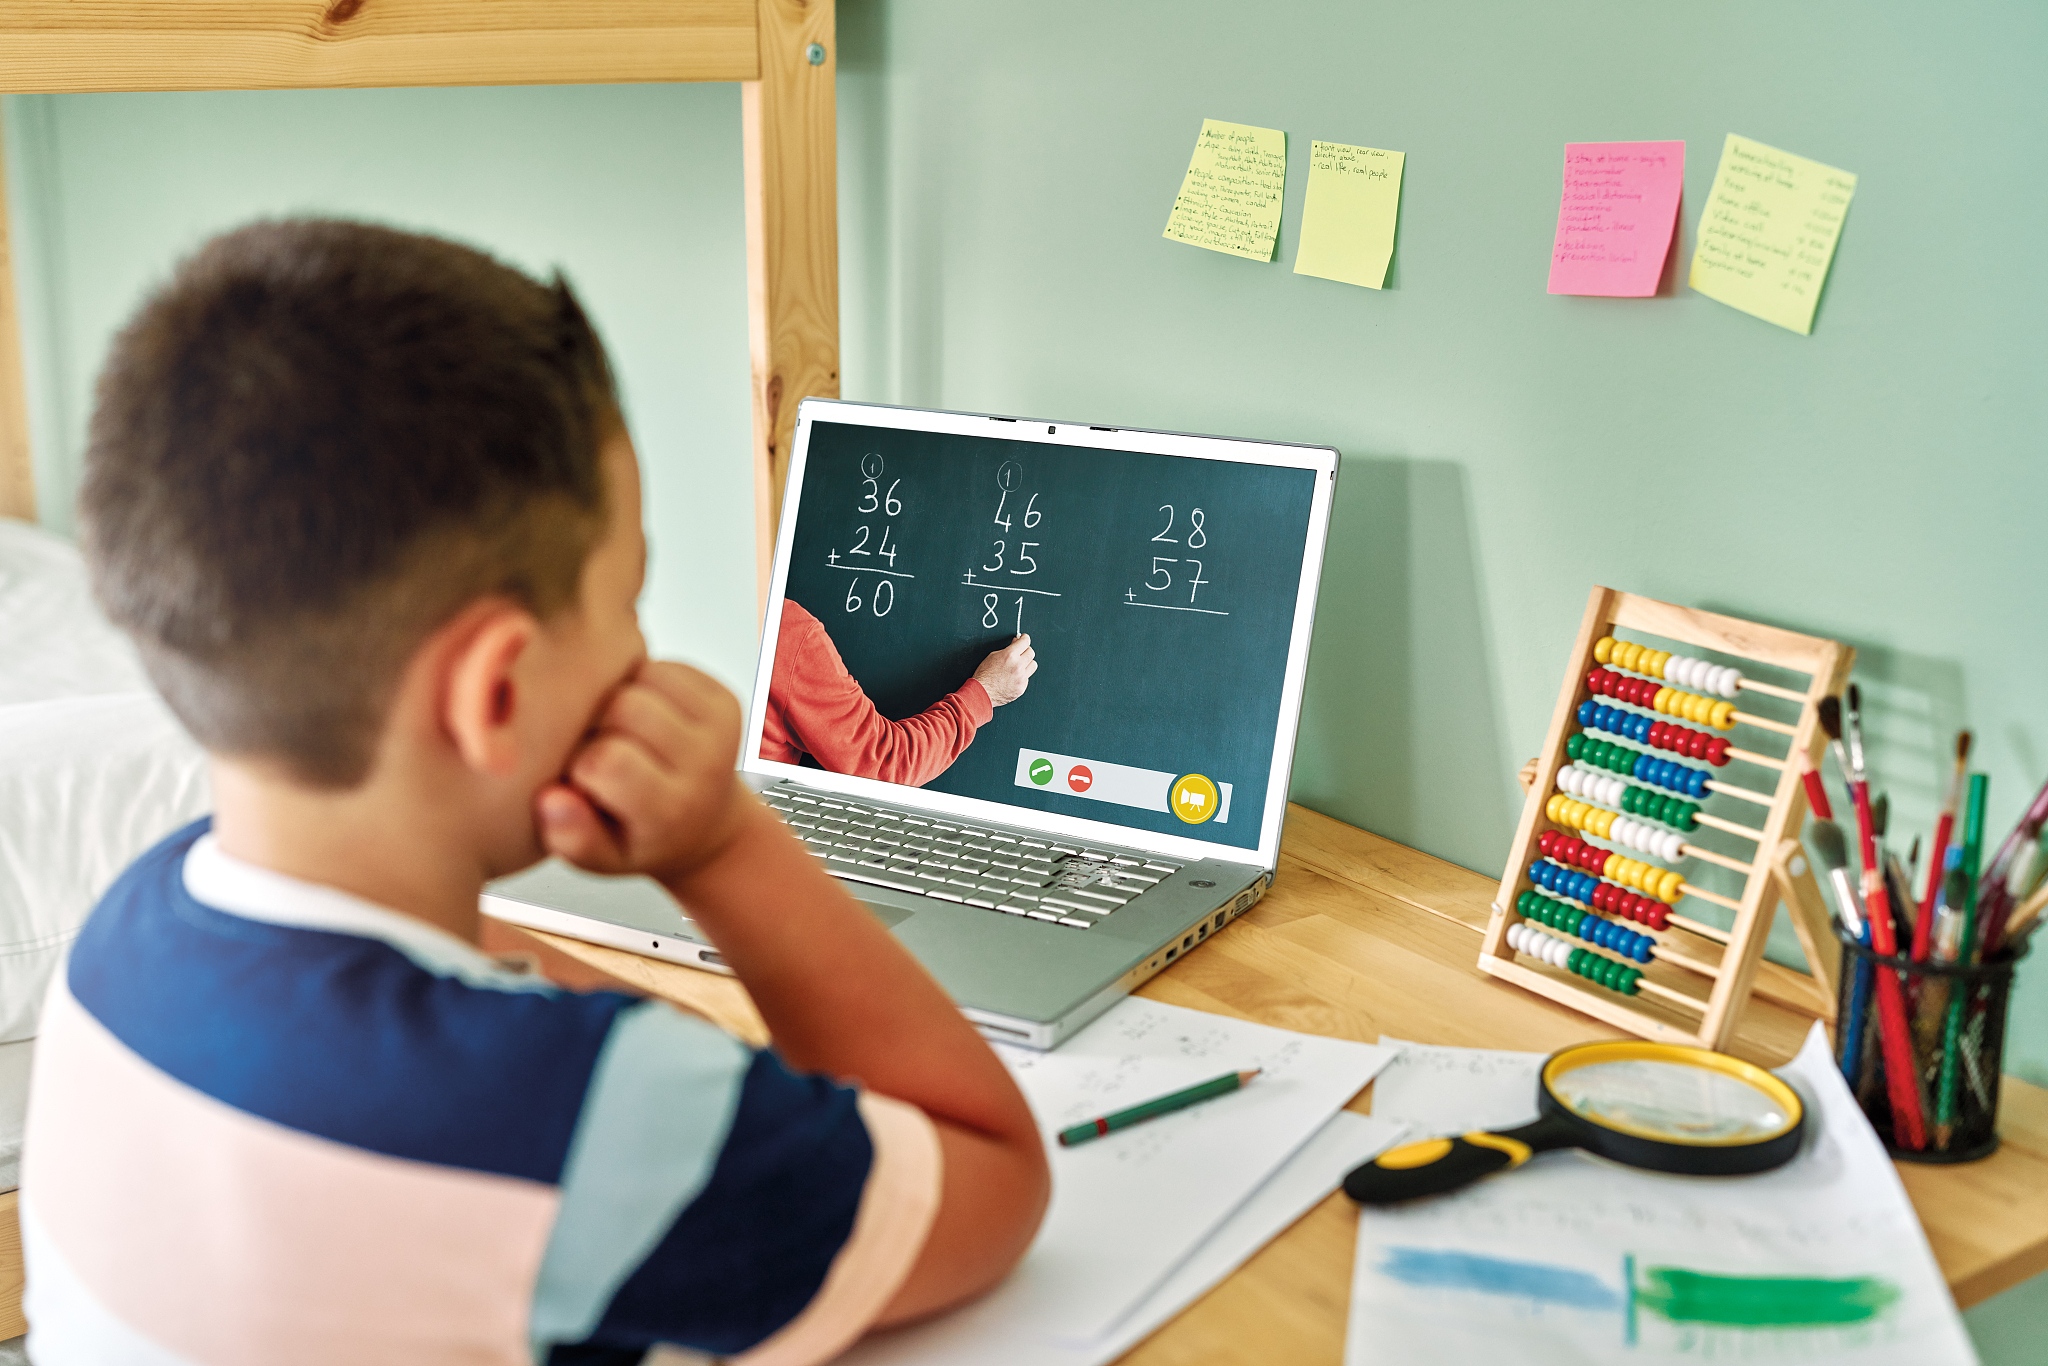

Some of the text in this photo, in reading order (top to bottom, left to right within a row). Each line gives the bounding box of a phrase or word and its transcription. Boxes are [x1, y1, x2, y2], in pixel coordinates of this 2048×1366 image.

[1204, 141, 1220, 153] Age
[1236, 132, 1255, 145] people
[1194, 168, 1214, 181] People
[1318, 161, 1333, 171] real
[1353, 165, 1368, 175] real
[1369, 169, 1388, 181] people
[1220, 205, 1252, 218] Caucasian
[857, 478, 902, 517] 36
[994, 490, 1042, 533] 46
[849, 525, 897, 567] 24
[1151, 504, 1207, 549] 28
[983, 540, 1040, 575] 35
[845, 577, 894, 617] 60
[1145, 556, 1209, 603] 57
[982, 593, 1024, 635] 81
